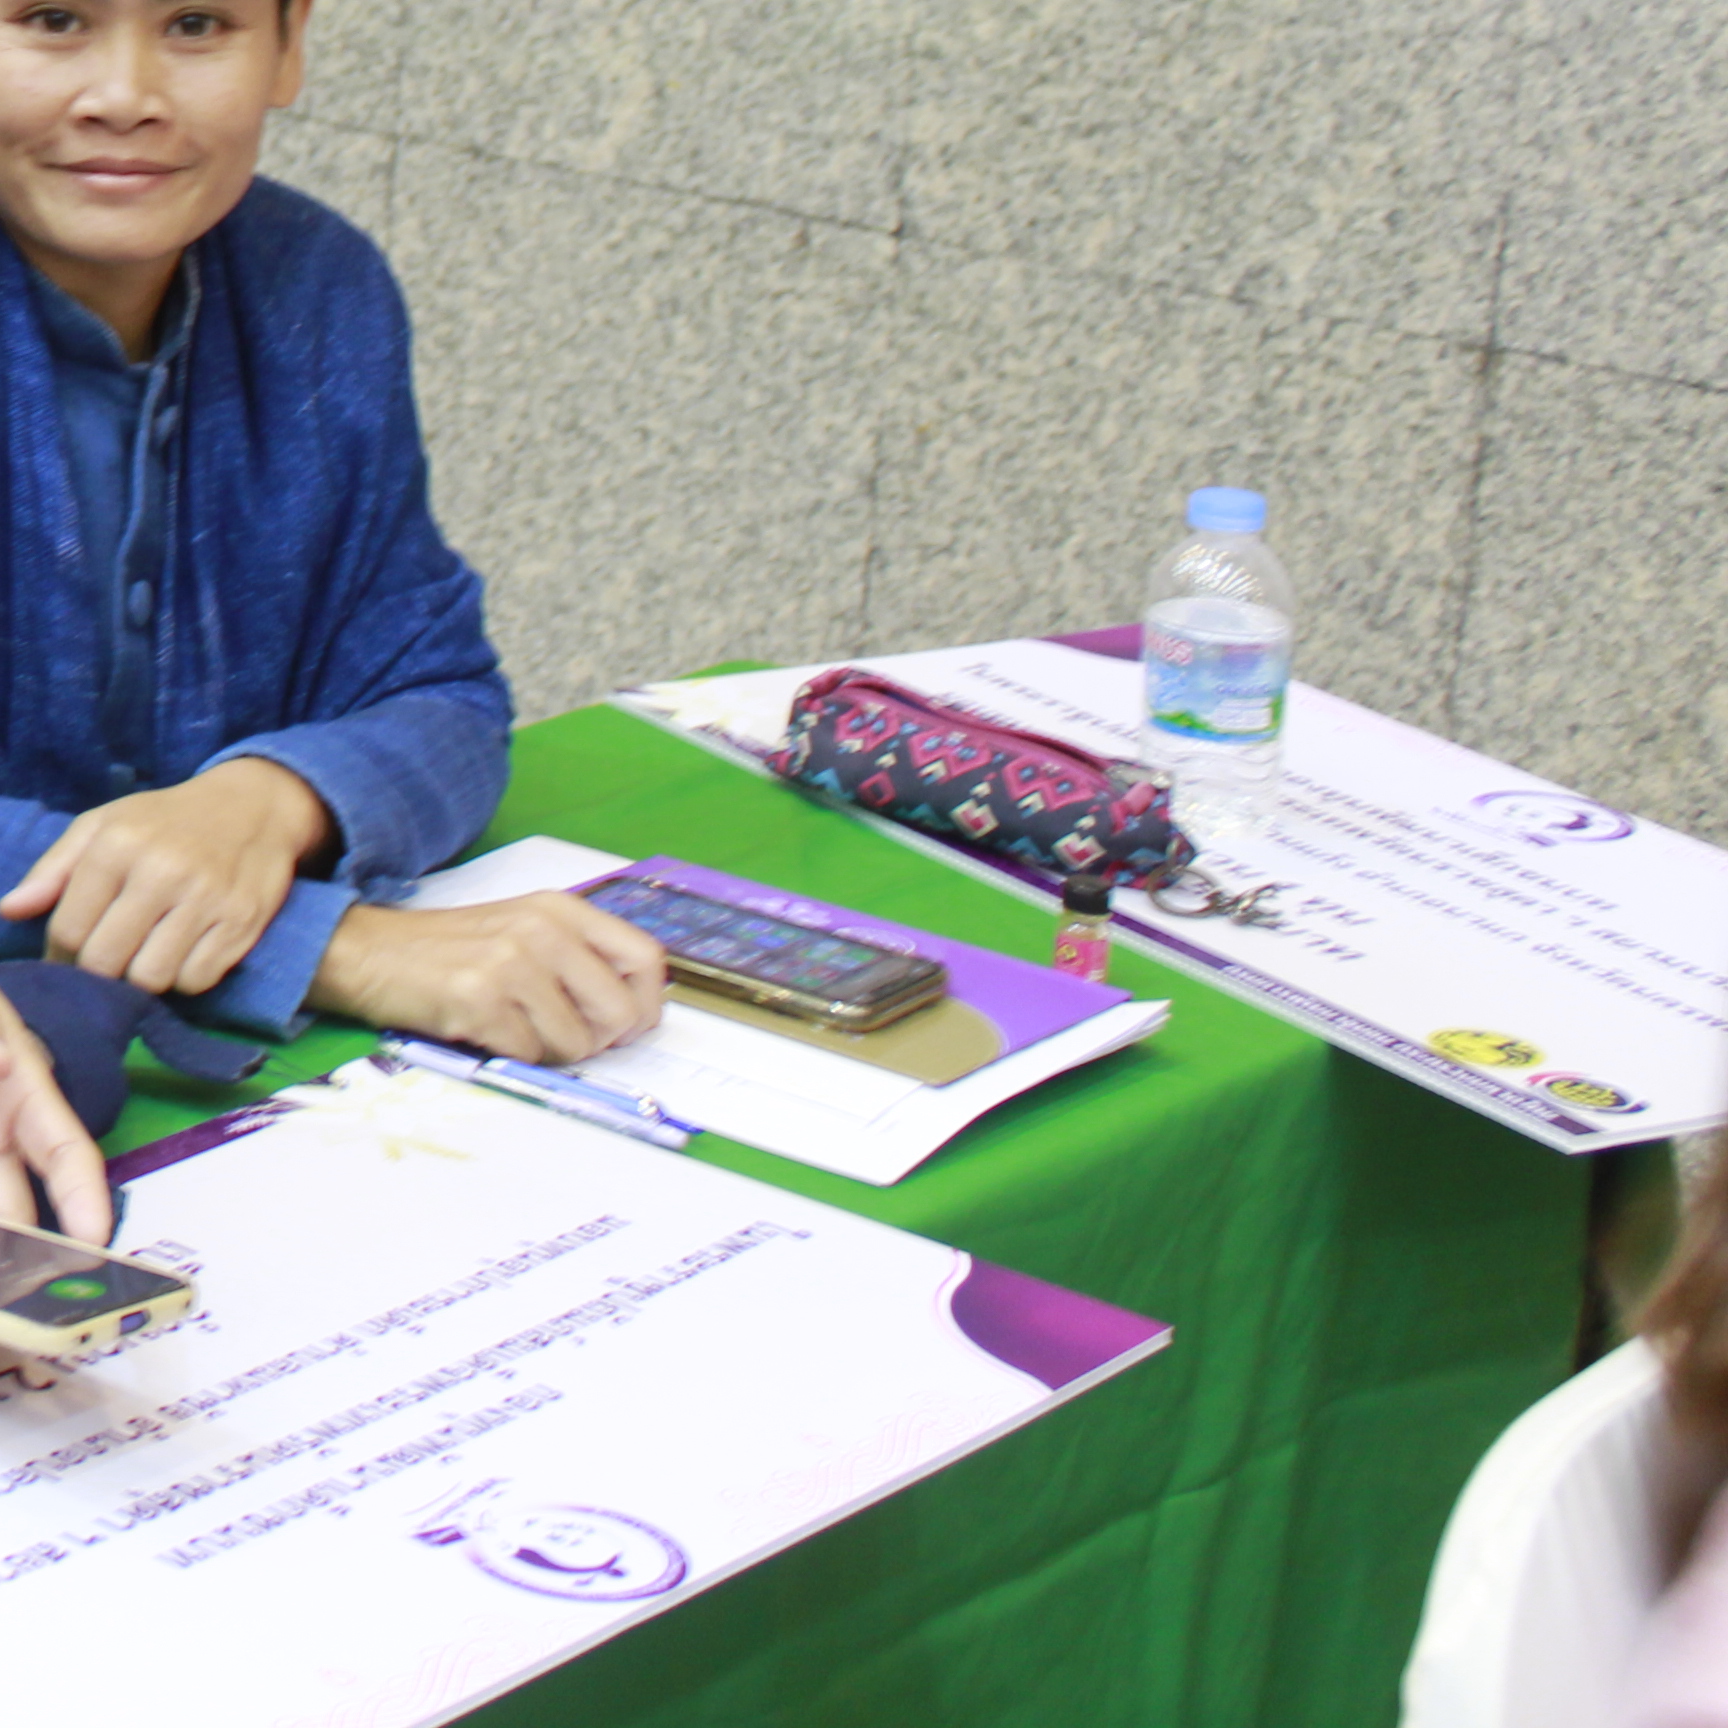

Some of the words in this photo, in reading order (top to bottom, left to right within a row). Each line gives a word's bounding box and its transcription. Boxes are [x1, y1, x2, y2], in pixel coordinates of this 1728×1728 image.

[159, 1374, 564, 1569] กองทุนพัฒนาเด็กชนบท
